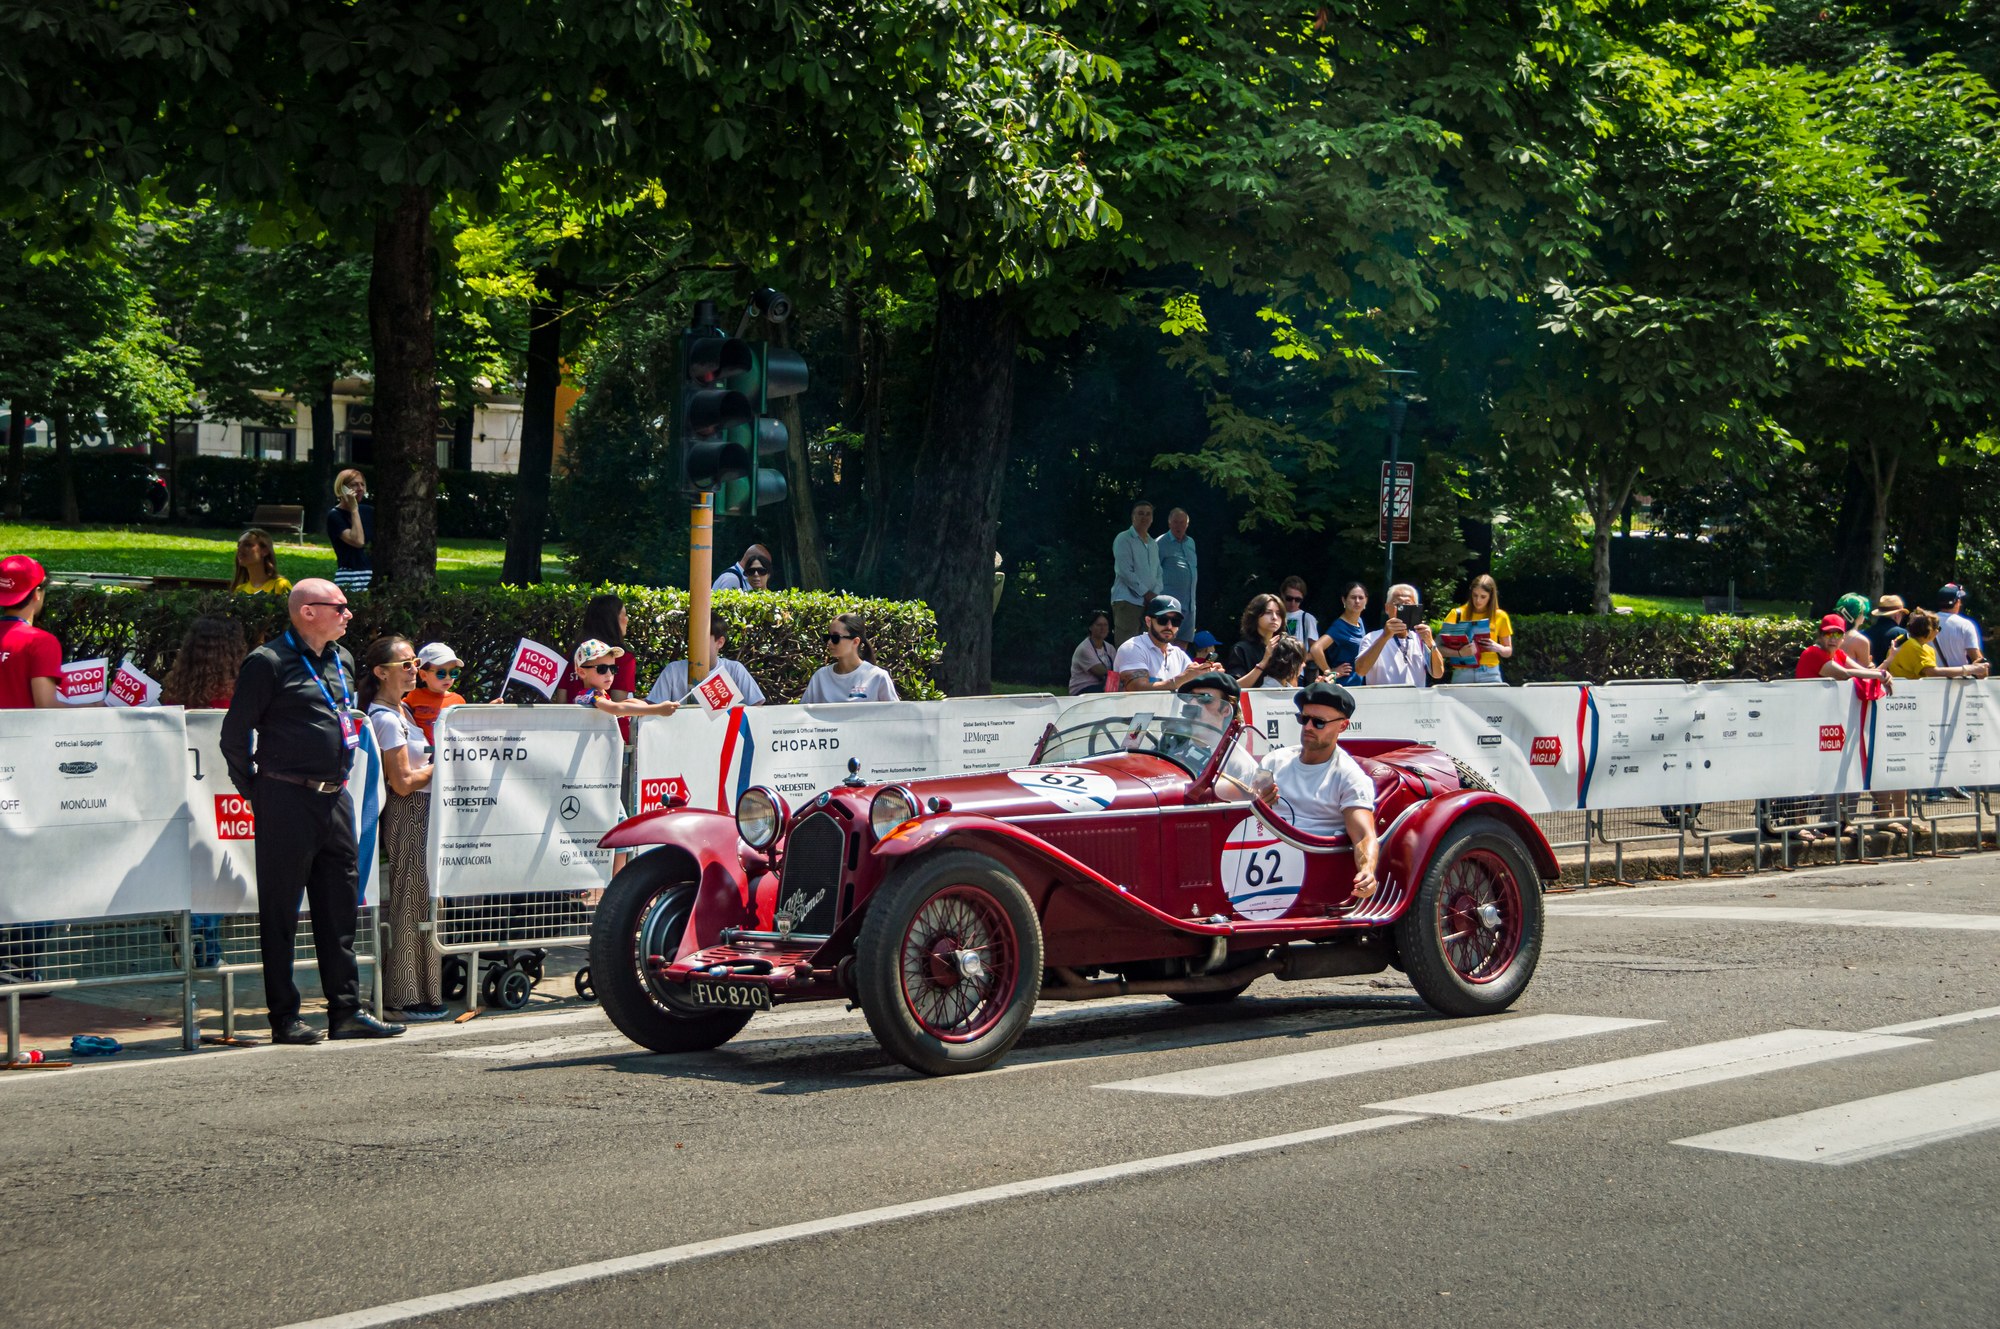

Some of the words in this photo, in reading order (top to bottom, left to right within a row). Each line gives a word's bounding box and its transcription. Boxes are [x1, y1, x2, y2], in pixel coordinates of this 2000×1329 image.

[525, 652, 553, 670] 1000
[67, 670, 102, 682] 1000
[518, 662, 550, 683] MIGLIA
[117, 671, 140, 692] 1000
[68, 682, 103, 695] MIGLIA
[713, 679, 729, 698] 1000
[701, 684, 721, 708] MIGLIA
[1885, 703, 1917, 711] CHOPARD
[1821, 728, 1840, 737] 1000
[80, 740, 103, 748] Supplier
[771, 738, 840, 752] CHOPARD
[1535, 740, 1557, 749] 1000
[1820, 740, 1841, 749] MIGLIA
[443, 748, 528, 761] CHOPARD
[1530, 753, 1557, 763] MIGLIA
[775, 783, 816, 792] VREDESTEIN
[1040, 773, 1088, 790] 62
[645, 782, 678, 797] 1000
[221, 798, 252, 814] 100
[443, 797, 498, 807] VREDESTEIN
[643, 801, 667, 814] MIG
[220, 820, 255, 836] MIGL
[455, 841, 479, 849] Sparkling
[582, 837, 600, 845] Sponso
[441, 855, 492, 866] FRANCIACORTA
[572, 850, 612, 858] MARREYT
[1245, 849, 1284, 887] 62
